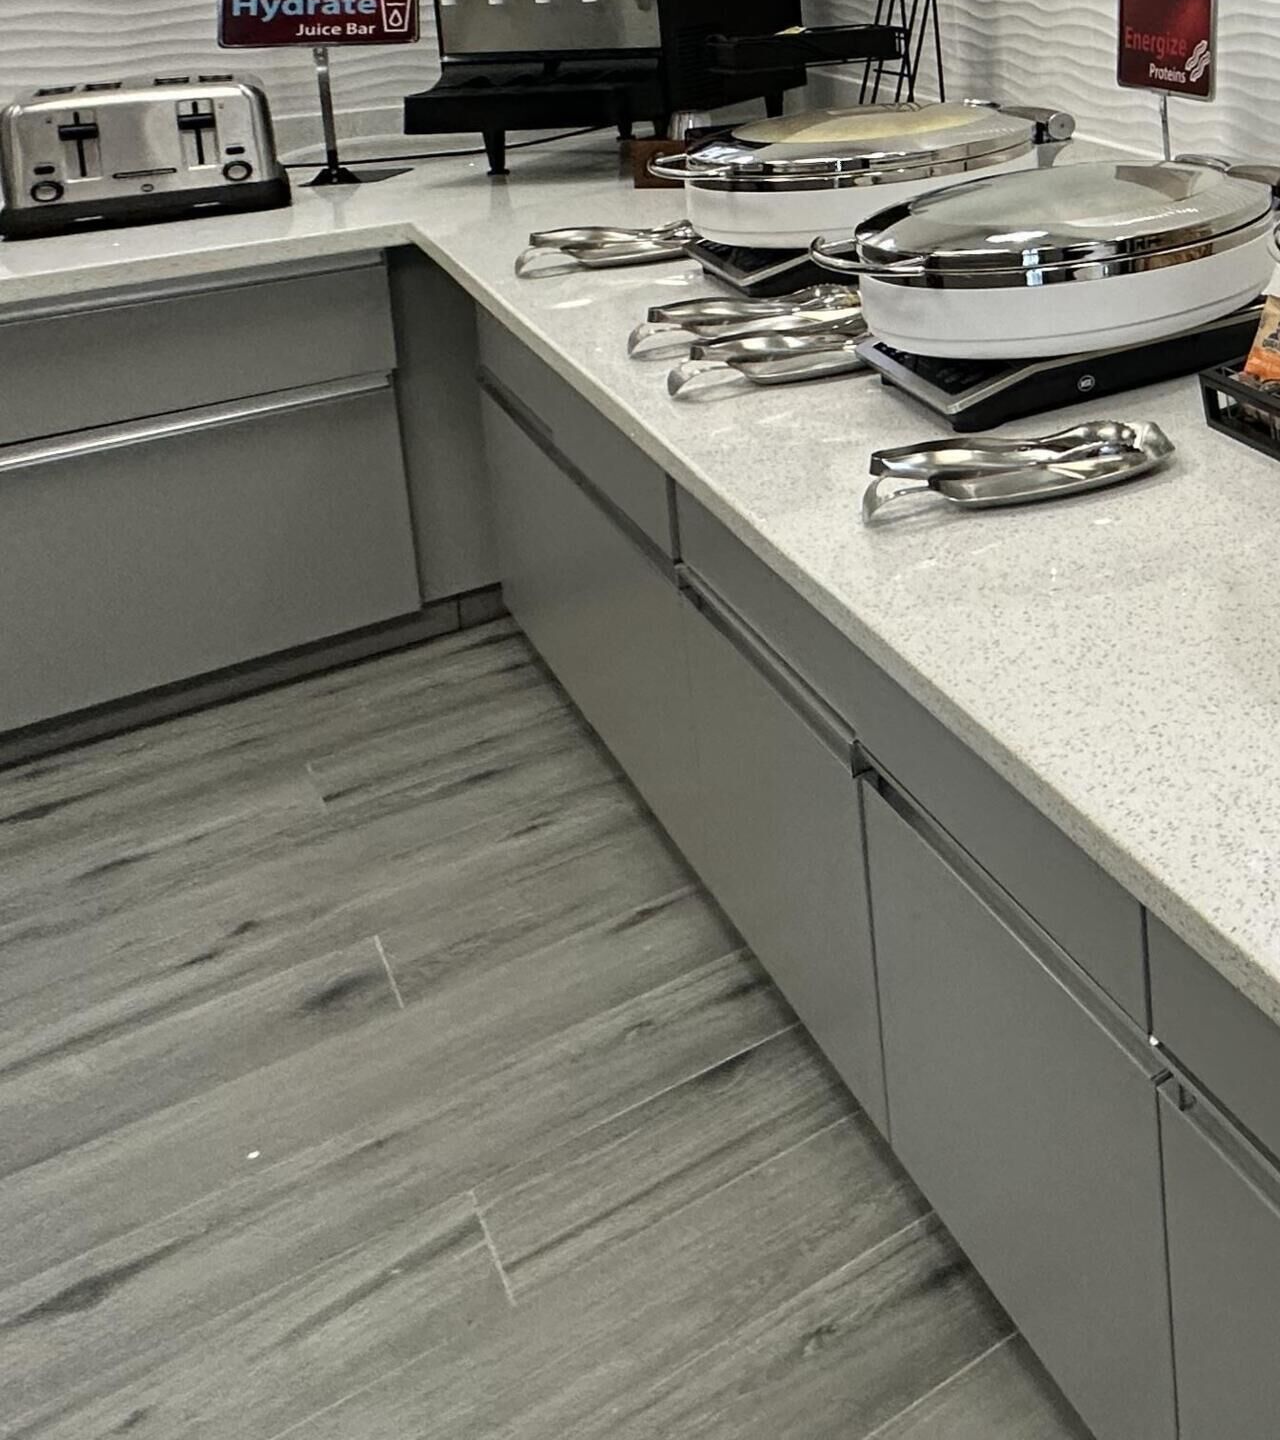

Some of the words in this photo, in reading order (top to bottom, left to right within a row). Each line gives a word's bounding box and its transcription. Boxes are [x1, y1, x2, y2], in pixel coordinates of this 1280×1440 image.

[296, 23, 341, 36] Juice
[346, 24, 376, 35] Bar
[1125, 26, 1187, 59] Energize
[1149, 63, 1186, 83] Proteins
